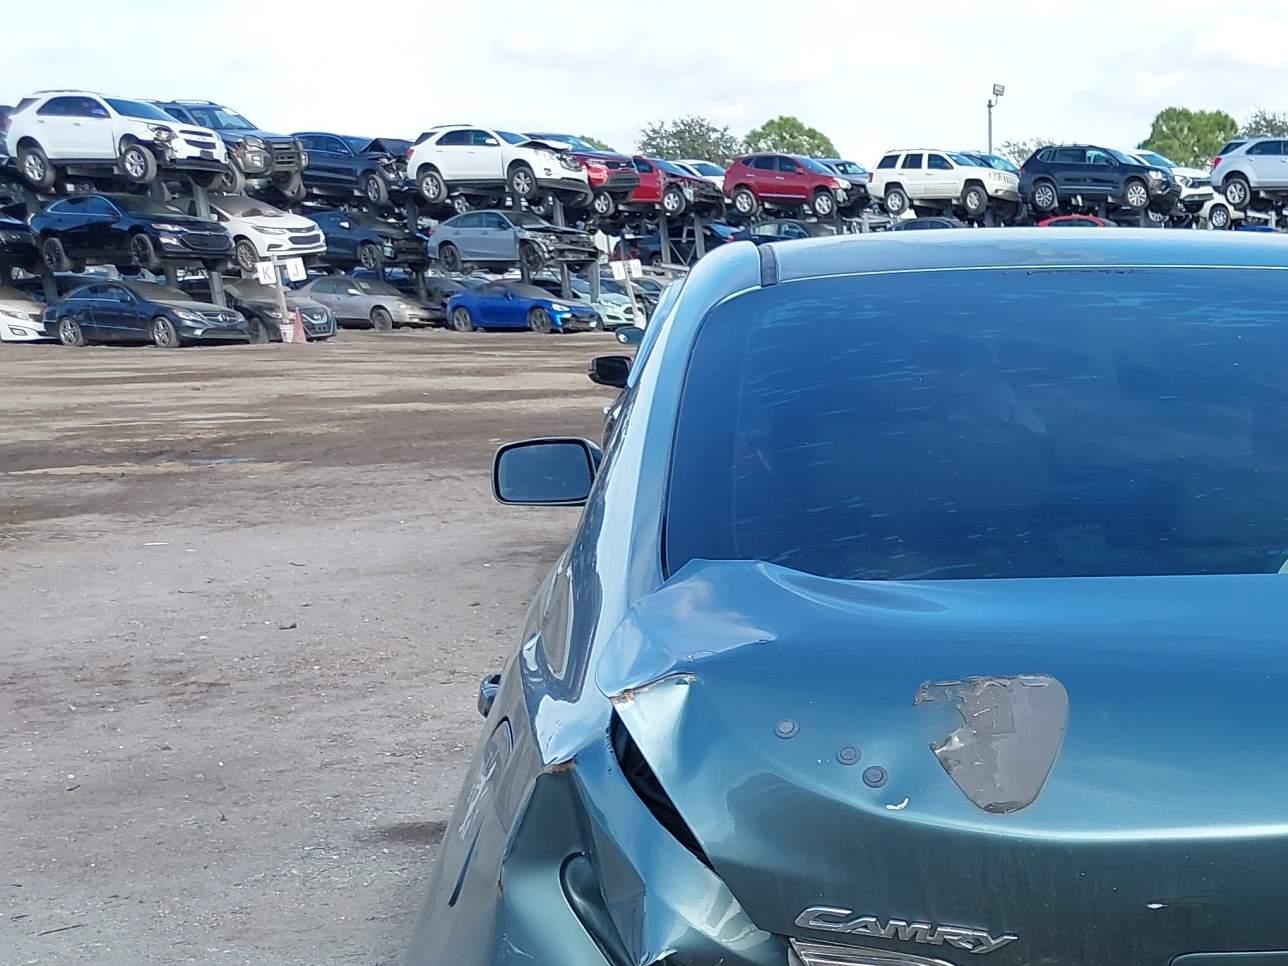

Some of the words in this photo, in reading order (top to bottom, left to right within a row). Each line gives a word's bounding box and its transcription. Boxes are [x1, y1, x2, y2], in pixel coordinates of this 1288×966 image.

[262, 266, 272, 280] K
[292, 263, 299, 277] J
[795, 905, 1019, 954] CAMRY
